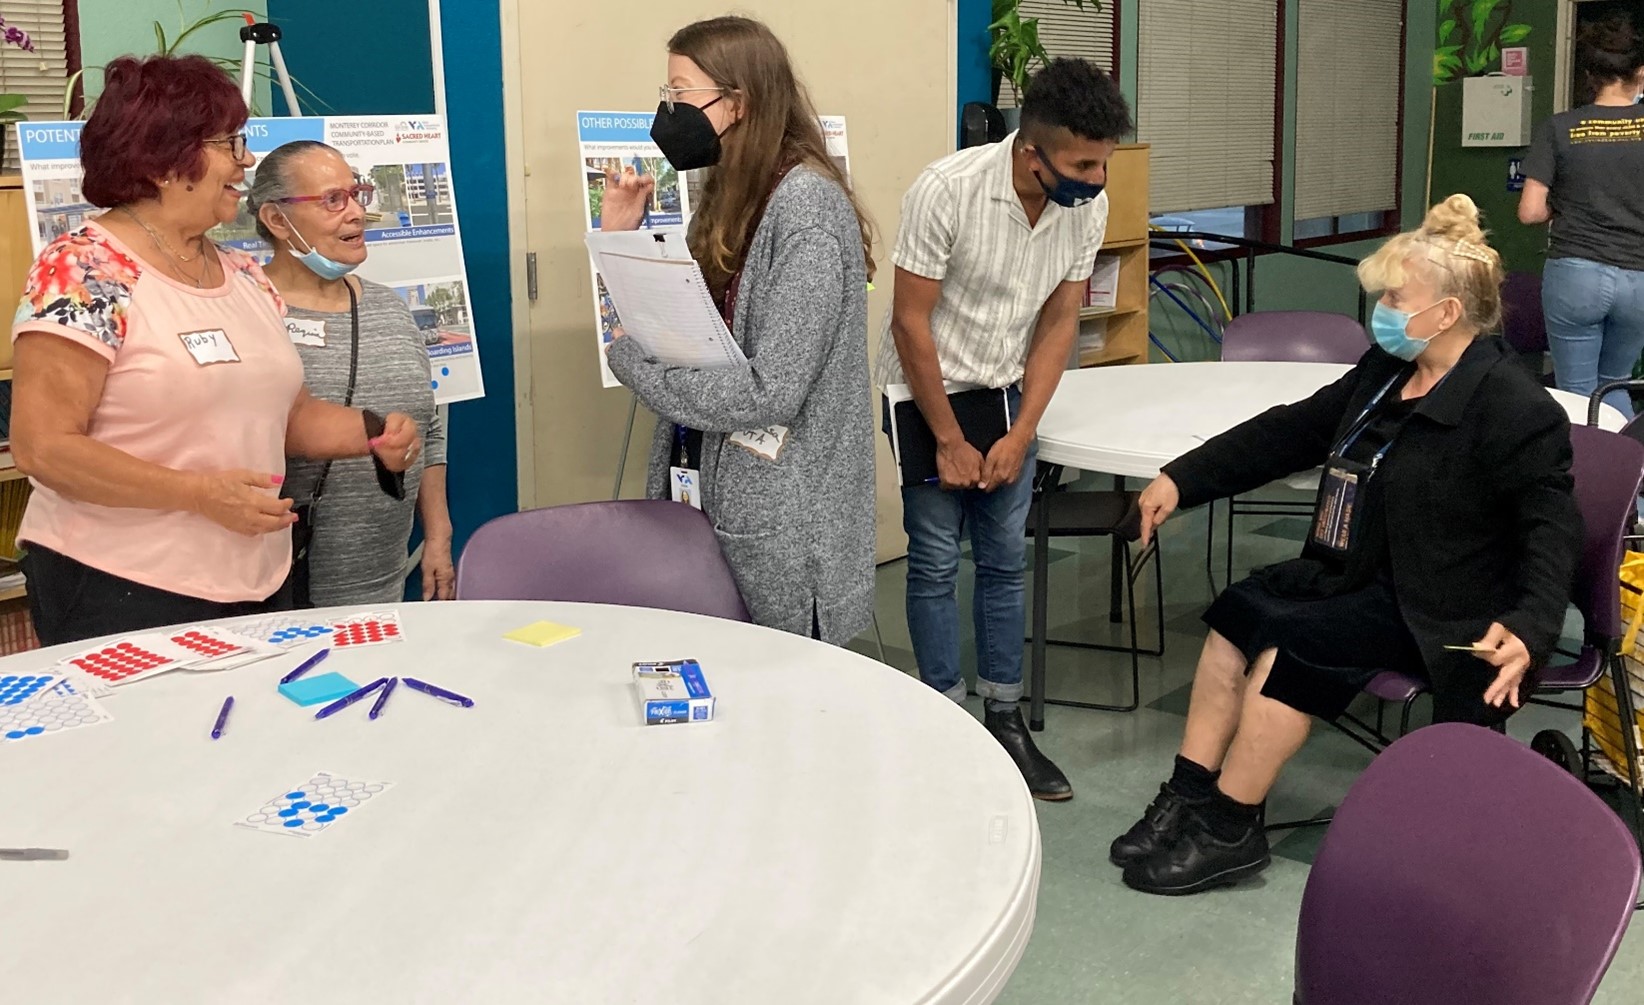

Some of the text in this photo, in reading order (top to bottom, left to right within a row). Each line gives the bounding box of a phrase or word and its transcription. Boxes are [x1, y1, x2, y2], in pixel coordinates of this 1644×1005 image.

[330, 121, 360, 129] MONTEREY
[582, 117, 613, 129] OTHER
[331, 130, 385, 138] COMMUNITY-BASED
[402, 131, 441, 140] SACRED HEART
[1468, 132, 1505, 141] FIRST AID
[333, 139, 379, 147] TRANSPORTATION
[379, 138, 394, 146] PLAN
[381, 226, 454, 239] Accessible Enhancements
[242, 241, 258, 249] Real
[184, 333, 217, 349] Ruby
